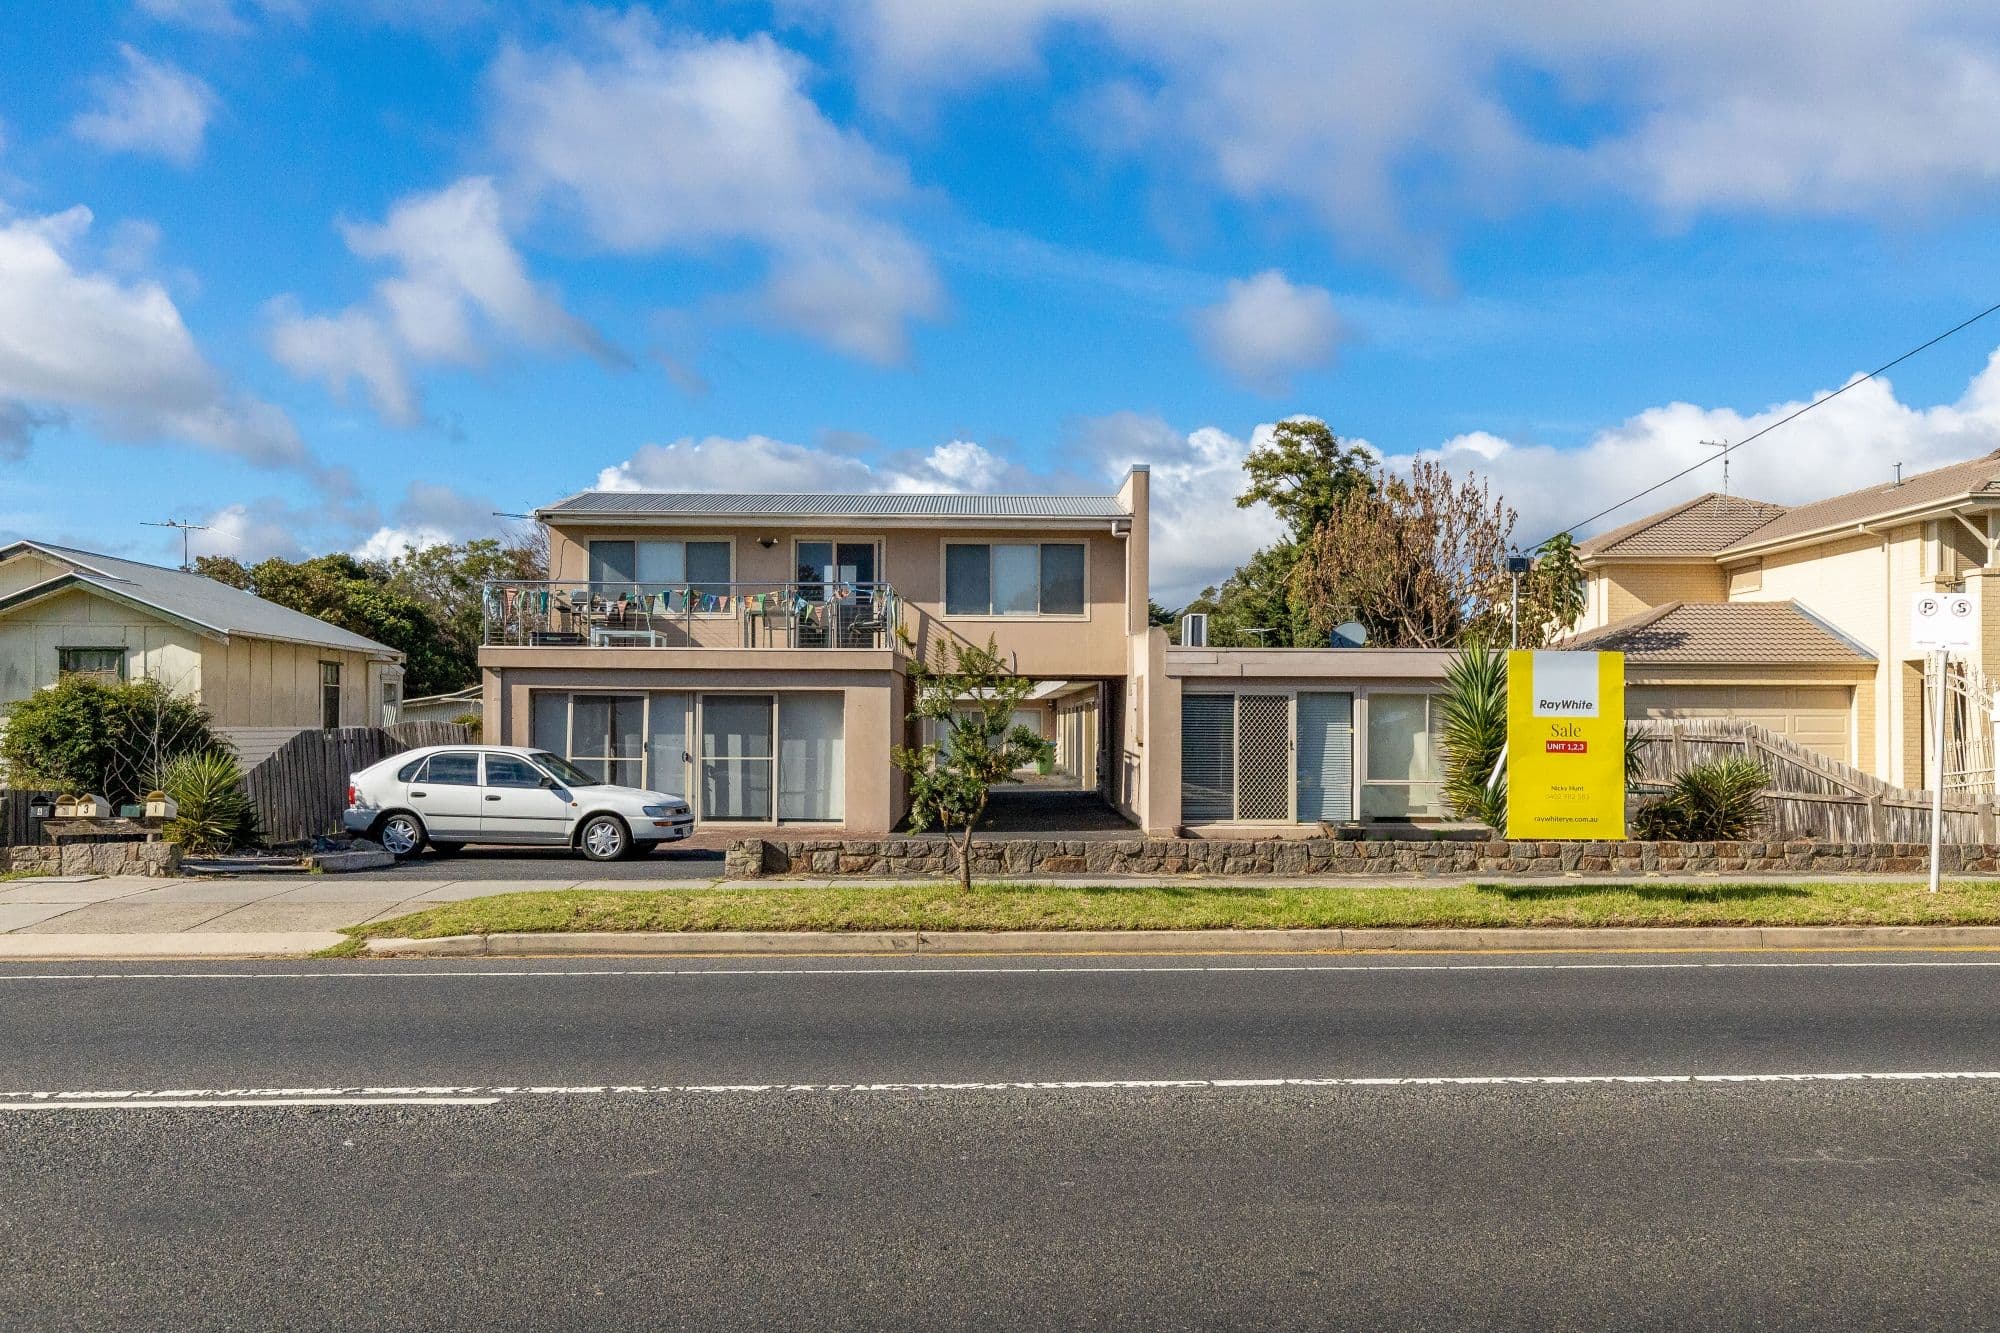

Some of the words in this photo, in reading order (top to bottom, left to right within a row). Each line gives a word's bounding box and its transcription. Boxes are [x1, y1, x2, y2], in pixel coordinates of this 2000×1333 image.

[1923, 602, 1934, 613] P
[1551, 723, 1582, 738] Sale
[83, 804, 89, 814] 3
[1534, 815, 1599, 823] raywhiterye.com.au
